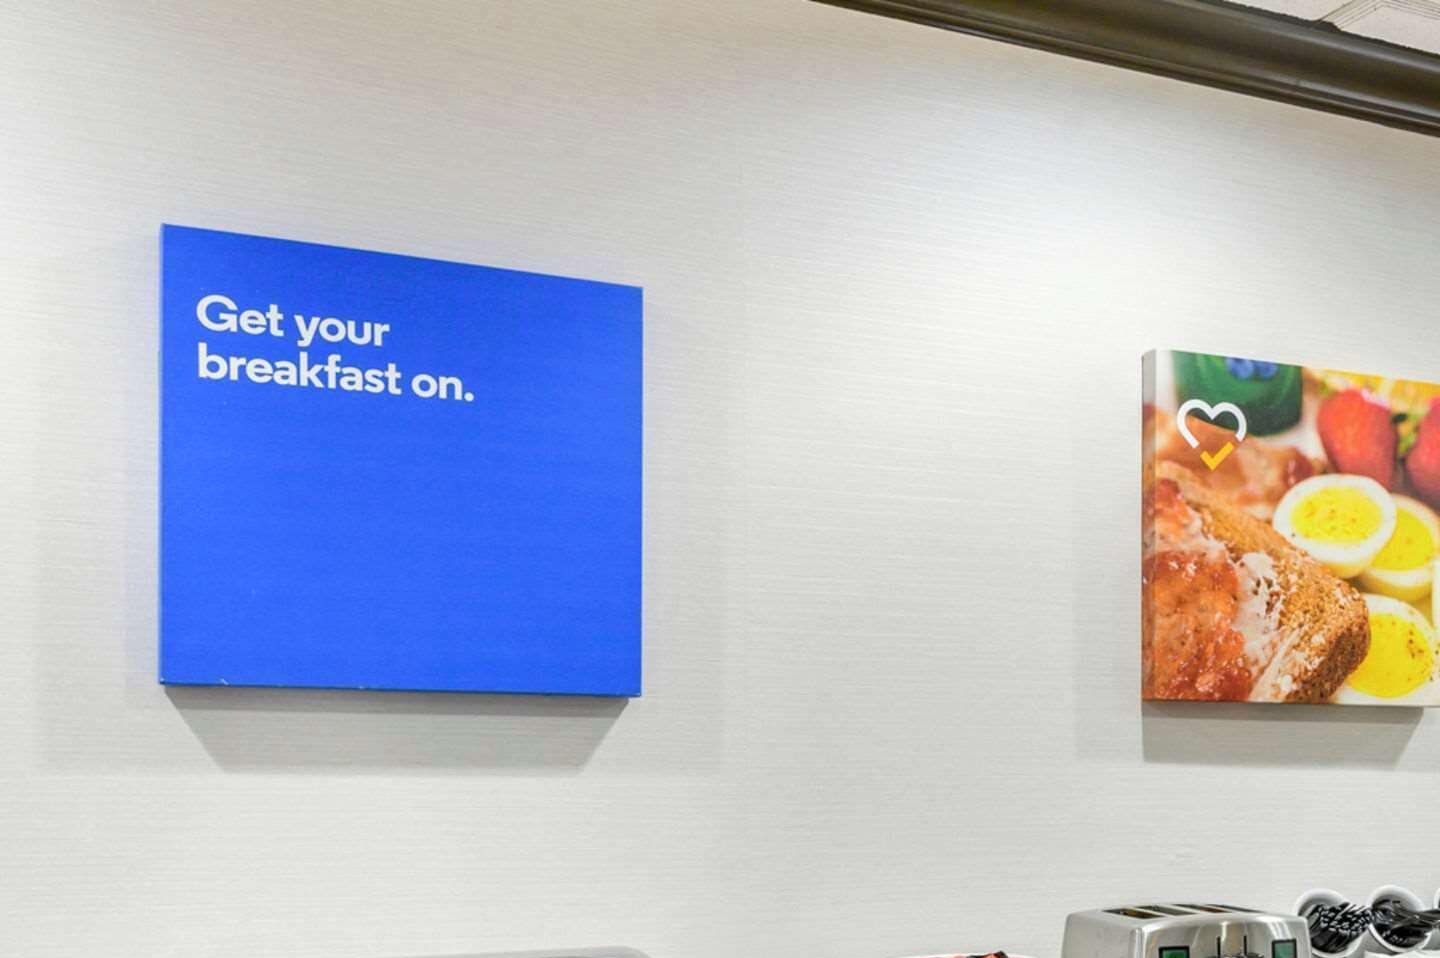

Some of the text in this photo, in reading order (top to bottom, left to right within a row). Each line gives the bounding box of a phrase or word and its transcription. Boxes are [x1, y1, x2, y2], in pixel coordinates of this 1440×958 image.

[196, 294, 391, 347] Get your
[198, 342, 475, 402] breakfast on.
